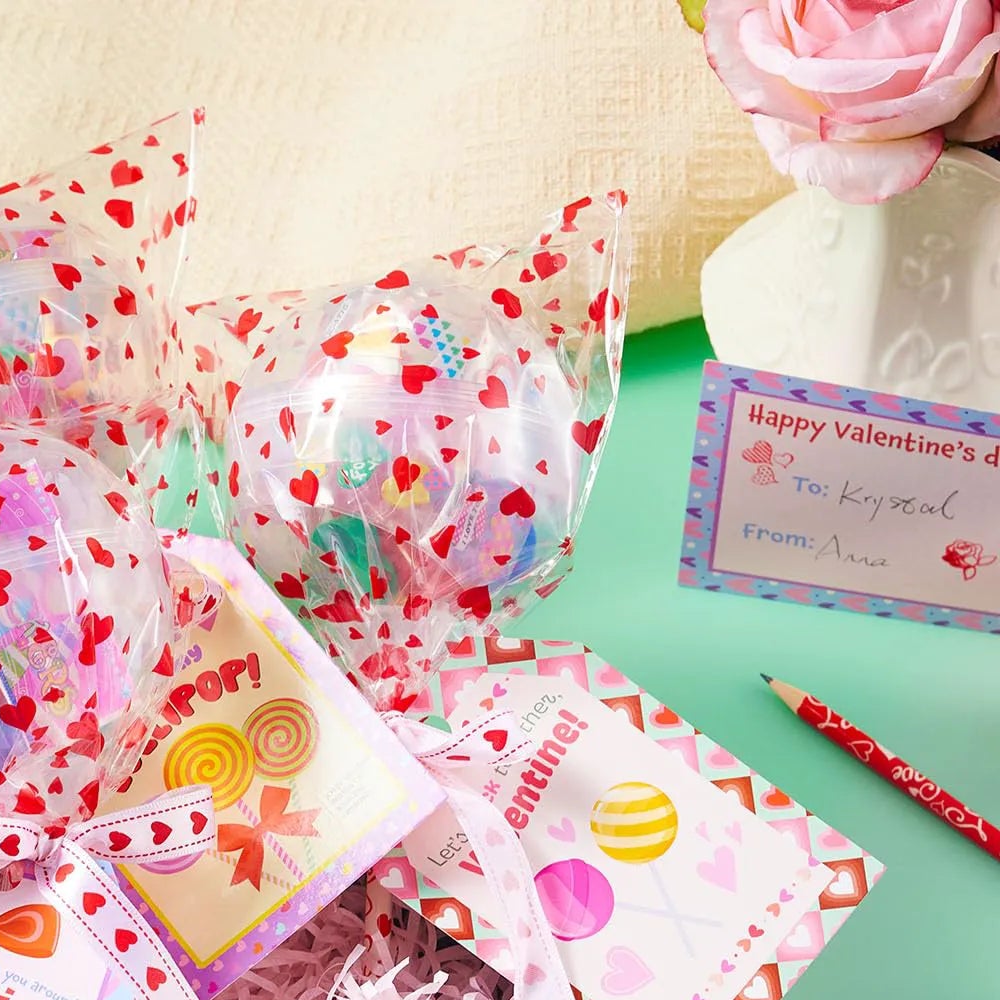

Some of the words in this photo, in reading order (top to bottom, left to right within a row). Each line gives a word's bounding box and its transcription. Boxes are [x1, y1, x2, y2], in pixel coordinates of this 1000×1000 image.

[748, 403, 827, 443] Happy
[835, 421, 977, 463] Valentine's
[792, 476, 830, 498] To:
[741, 523, 816, 550] From:
[3, 969, 28, 988] you
